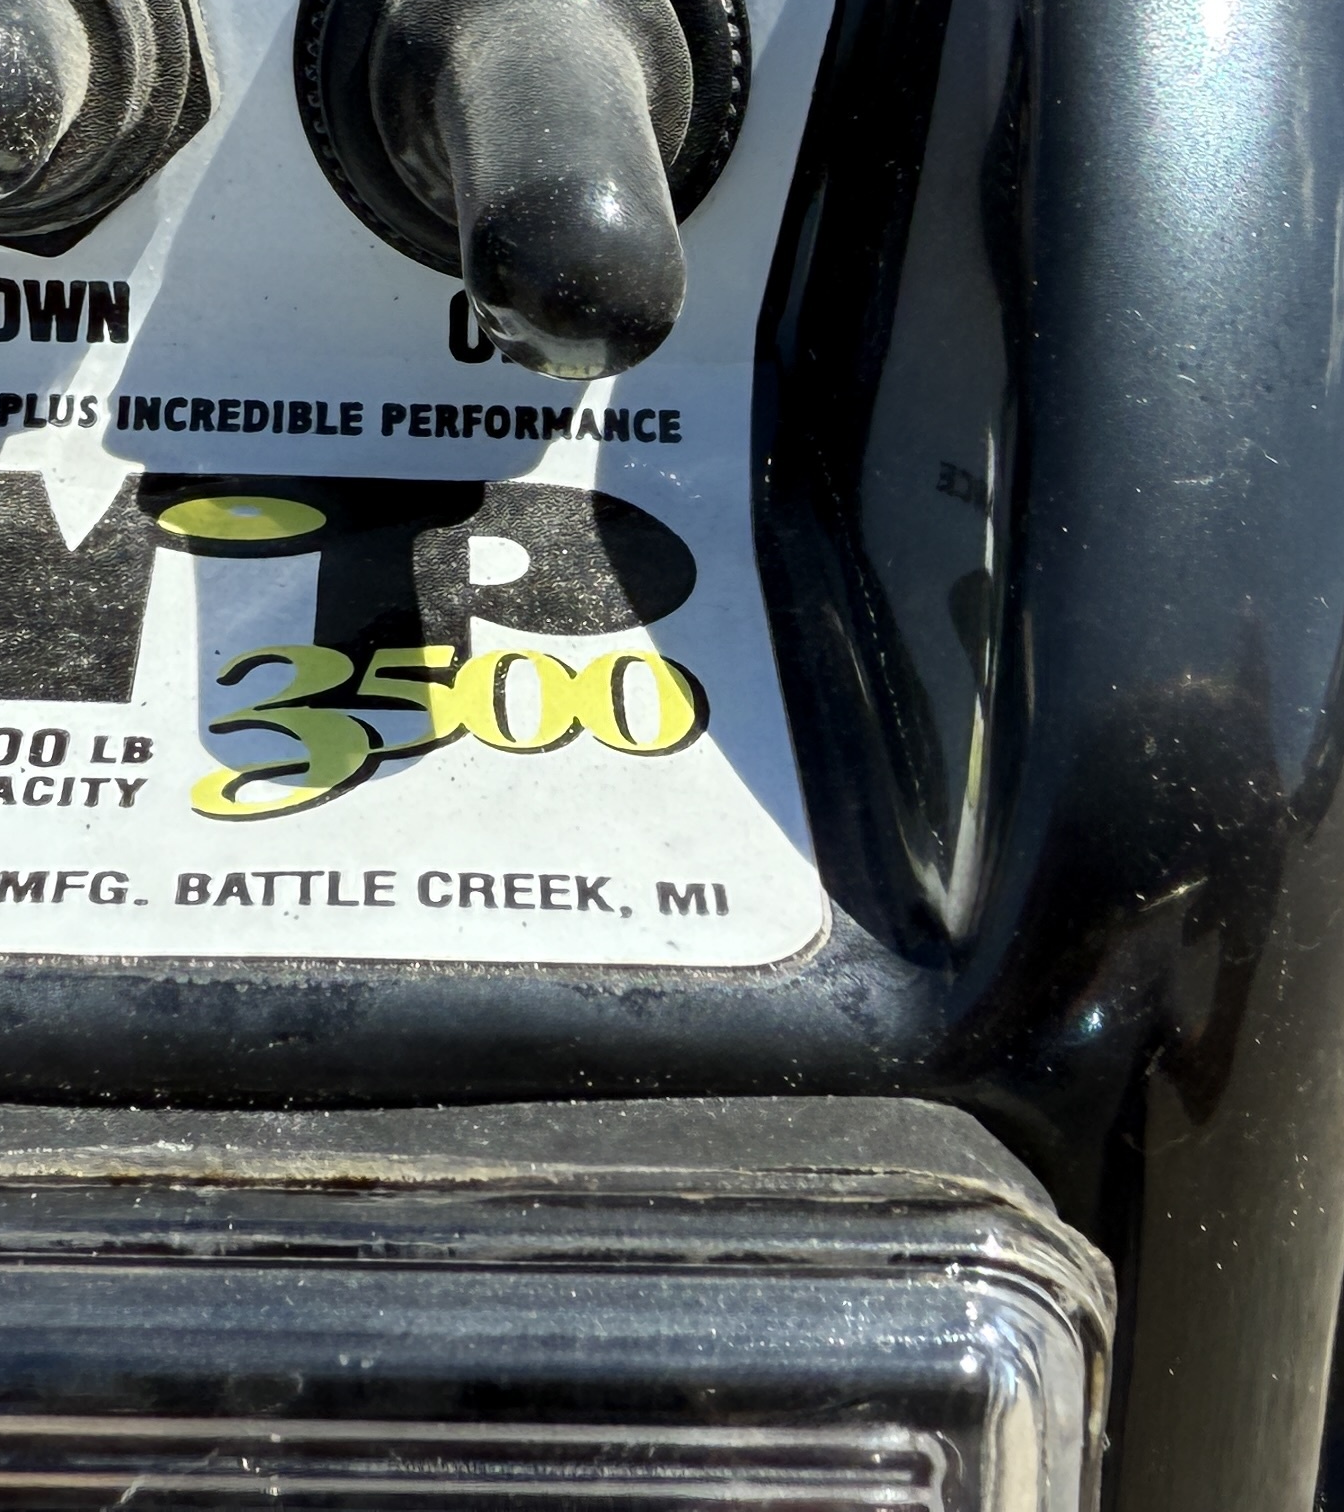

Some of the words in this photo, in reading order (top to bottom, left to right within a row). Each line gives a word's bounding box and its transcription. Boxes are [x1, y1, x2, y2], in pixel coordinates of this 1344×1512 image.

[116, 395, 364, 436] INCREDIBLE
[380, 402, 682, 444] PERFORMANCE
[90, 736, 154, 764] LB
[190, 644, 711, 822] 3500
[174, 870, 396, 907] BATTLE
[416, 870, 633, 919] CREEK,
[656, 881, 730, 916] MI
